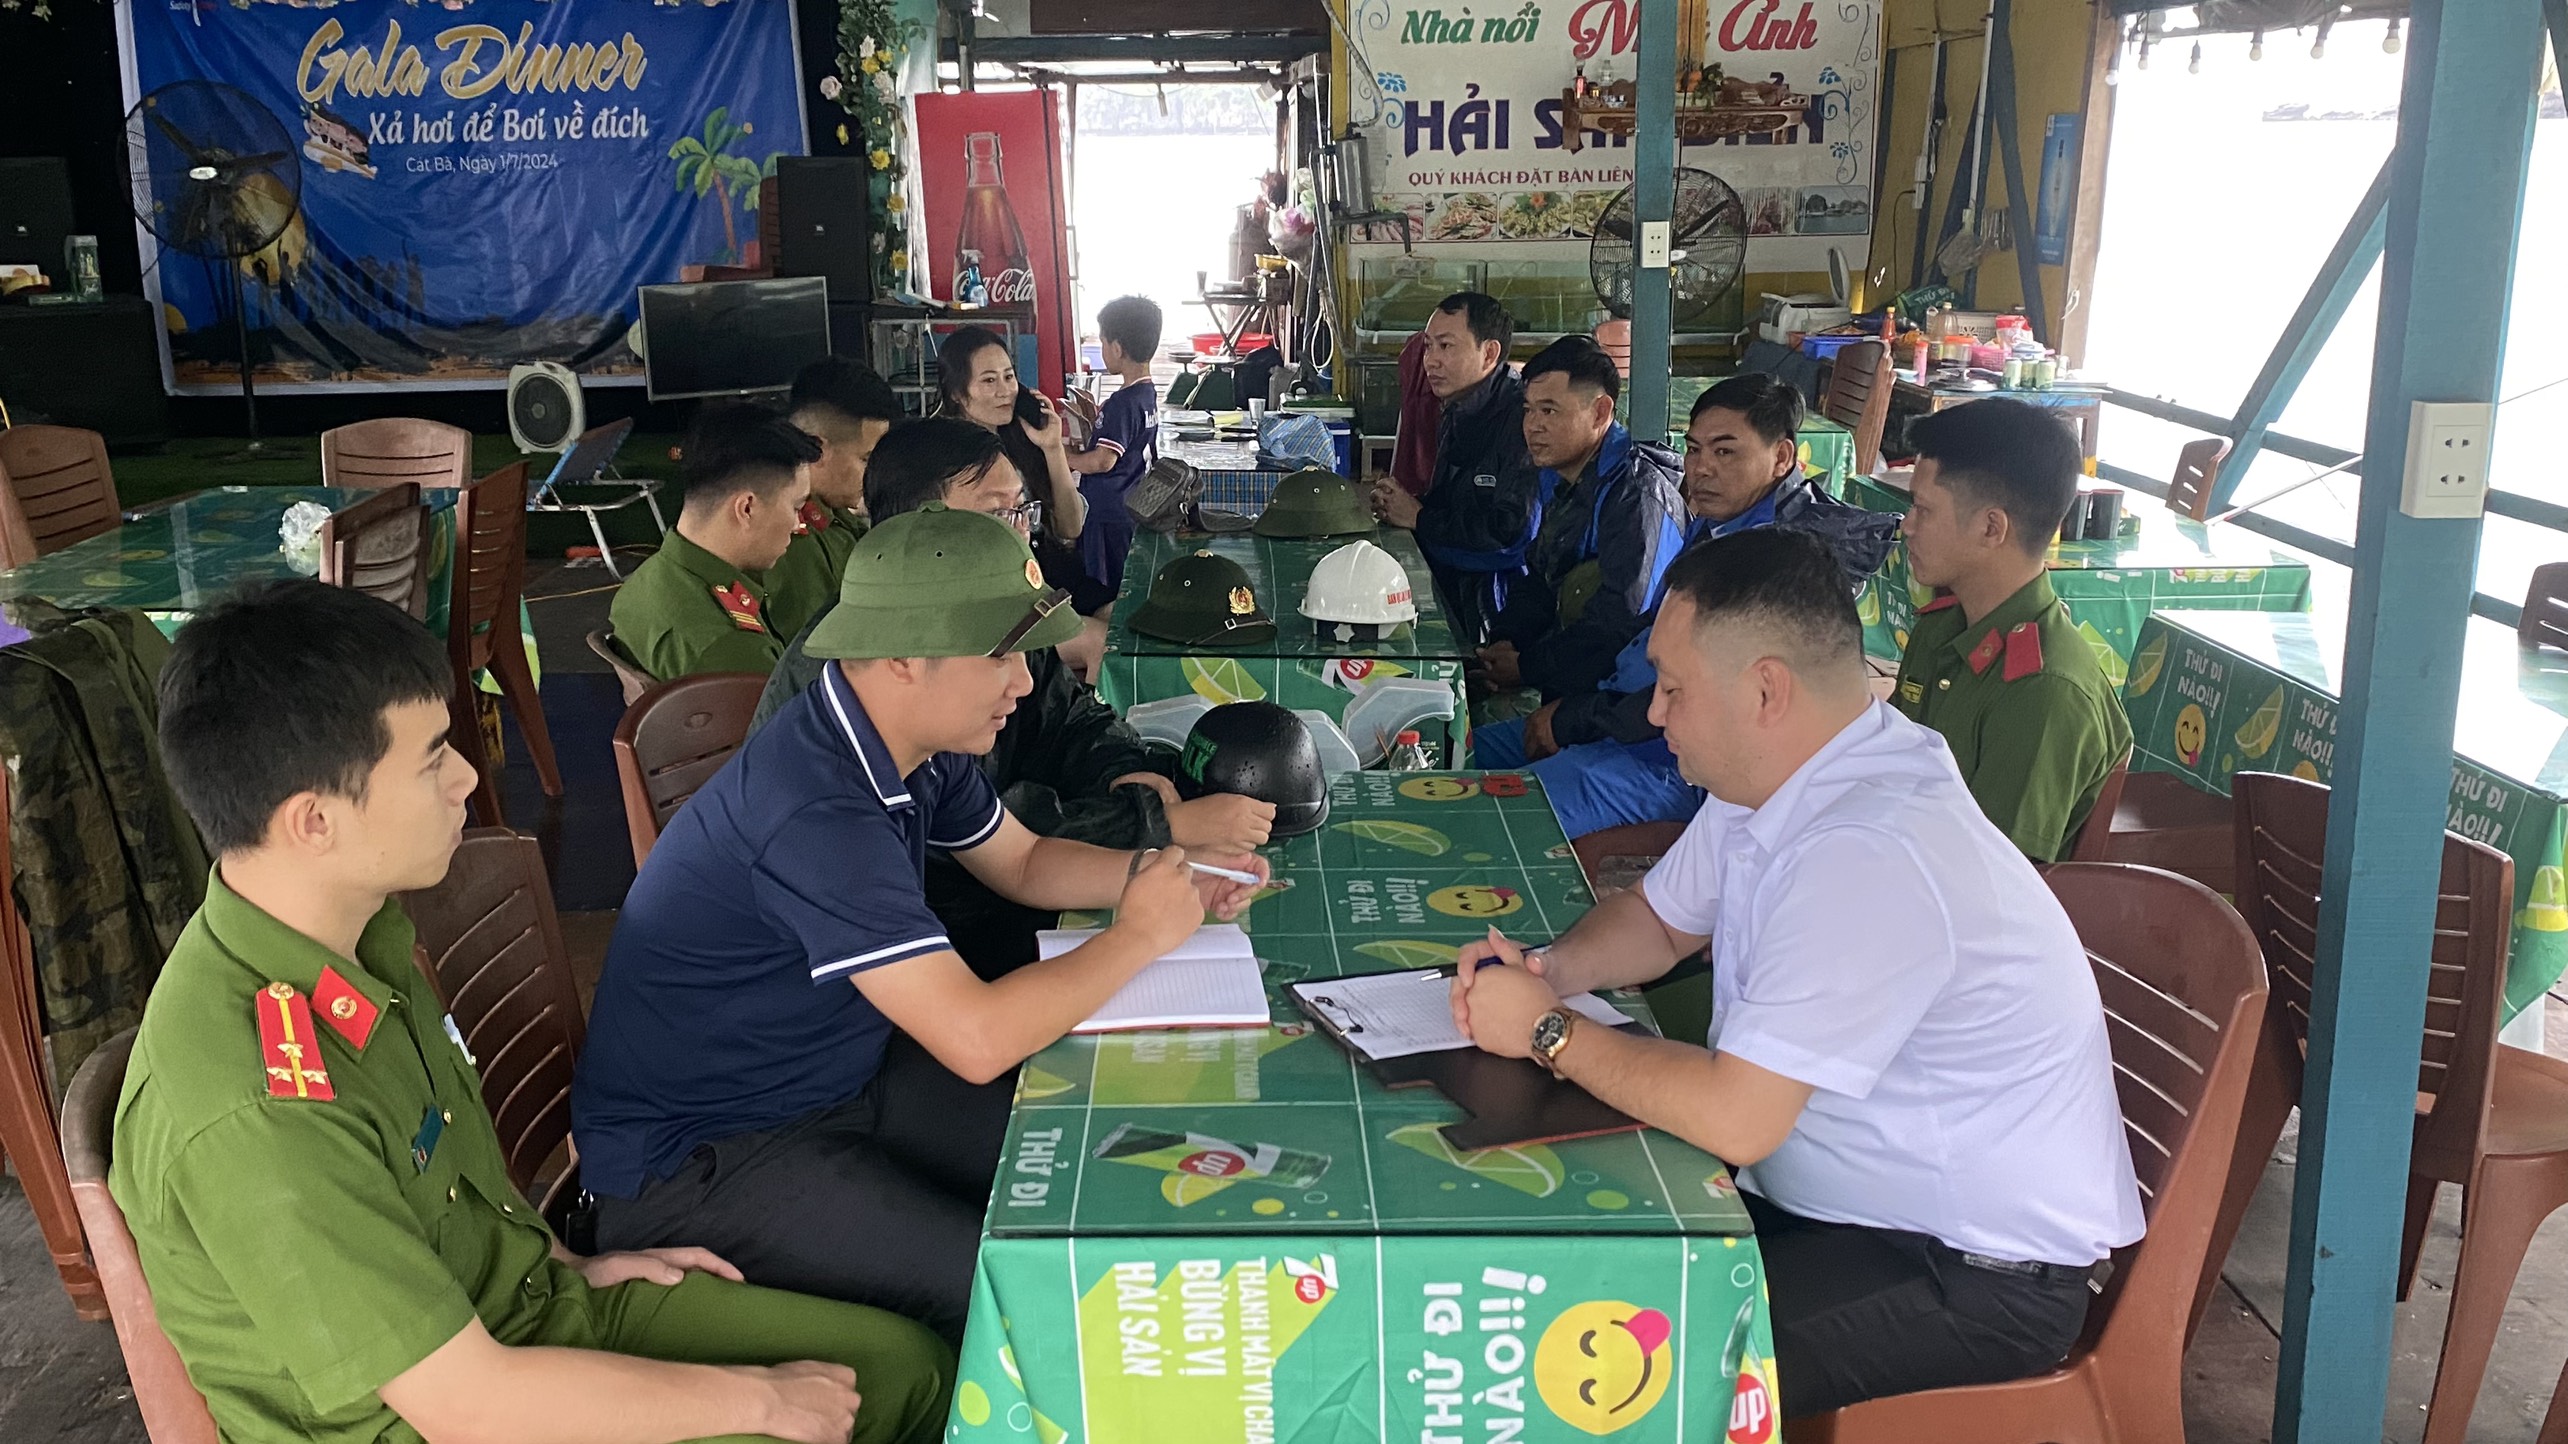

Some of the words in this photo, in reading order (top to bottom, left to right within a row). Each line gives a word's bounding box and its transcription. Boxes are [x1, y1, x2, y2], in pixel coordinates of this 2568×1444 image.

[1401, 6, 1475, 44] Nhà
[1480, 1, 1541, 44] nổi
[297, 17, 430, 104] Gala
[435, 20, 648, 99] Dinner
[368, 109, 404, 145] Xả
[412, 109, 455, 144] hơi
[462, 103, 497, 142] để
[503, 107, 547, 142] Bơi
[553, 100, 586, 140] về
[591, 104, 649, 140] đích
[1404, 83, 1511, 158] HẢI
[406, 156, 431, 173] Cát
[459, 154, 497, 176] Ngày
[500, 153, 558, 171] 1/7/2024
[1408, 168, 1445, 186] QUÝ
[1450, 168, 1512, 185] KHÁCH
[1516, 168, 1553, 187] ĐẶT
[1558, 166, 1594, 184] BÀN
[1599, 166, 1634, 182] LIÊN
[2177, 675, 2222, 719] NÀO!!!
[2485, 786, 2508, 812] ĐI
[1384, 877, 1429, 923] NÀO!!!
[1014, 1127, 1069, 1177] THỬ
[1008, 1182, 1050, 1207] ĐI
[1113, 1261, 1169, 1312] HẢI
[1236, 1256, 1270, 1331] THANH
[1423, 1282, 1463, 1336] ĐI
[1118, 1316, 1173, 1377] SẢN
[1177, 1346, 1227, 1376] VỊ
[1472, 1266, 1547, 1444] NÀO!!!
[1238, 1381, 1274, 1401] VỊ
